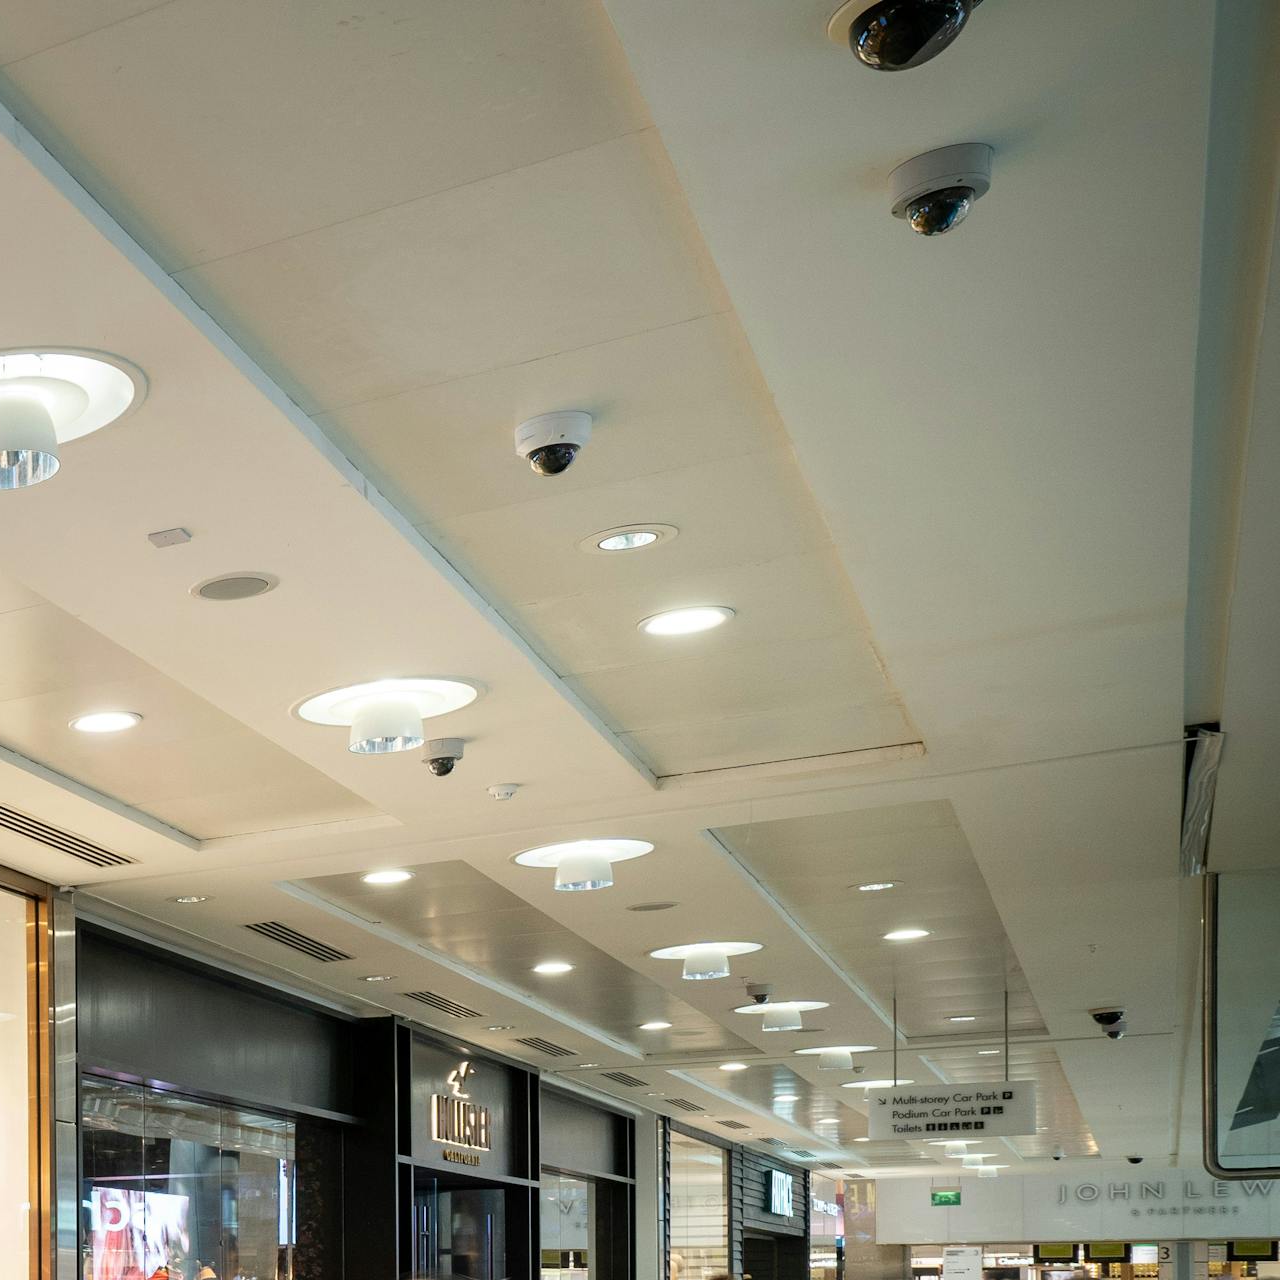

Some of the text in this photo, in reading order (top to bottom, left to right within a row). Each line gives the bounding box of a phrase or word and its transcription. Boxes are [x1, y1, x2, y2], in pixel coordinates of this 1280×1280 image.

[953, 1094, 973, 1102] Car
[976, 1091, 998, 1101] Park
[892, 1110, 929, 1120] Podium
[932, 1108, 952, 1118] Car
[955, 1106, 977, 1116] Park
[891, 1123, 922, 1134] Toilets
[1059, 1181, 1164, 1203] JOHN
[1160, 1247, 1170, 1260] 3
